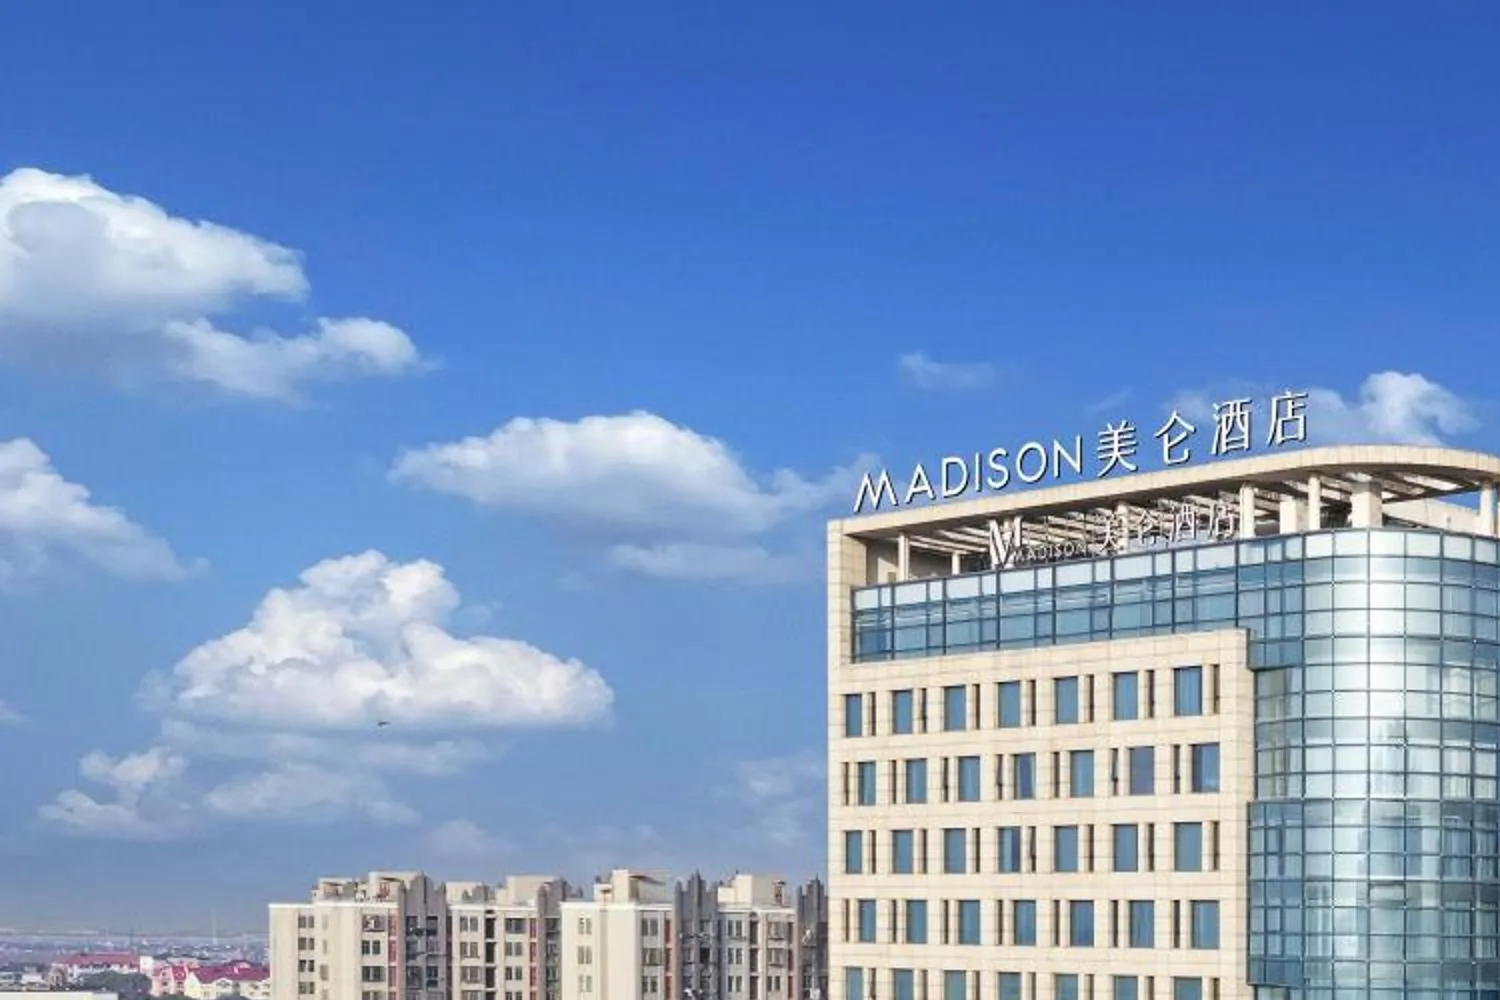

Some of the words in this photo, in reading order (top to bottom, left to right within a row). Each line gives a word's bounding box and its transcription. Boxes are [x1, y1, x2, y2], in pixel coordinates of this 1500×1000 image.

[853, 434, 1084, 514] MADISON
[1097, 389, 1309, 478] 美仑酒店
[1014, 541, 1087, 563] MADISON
